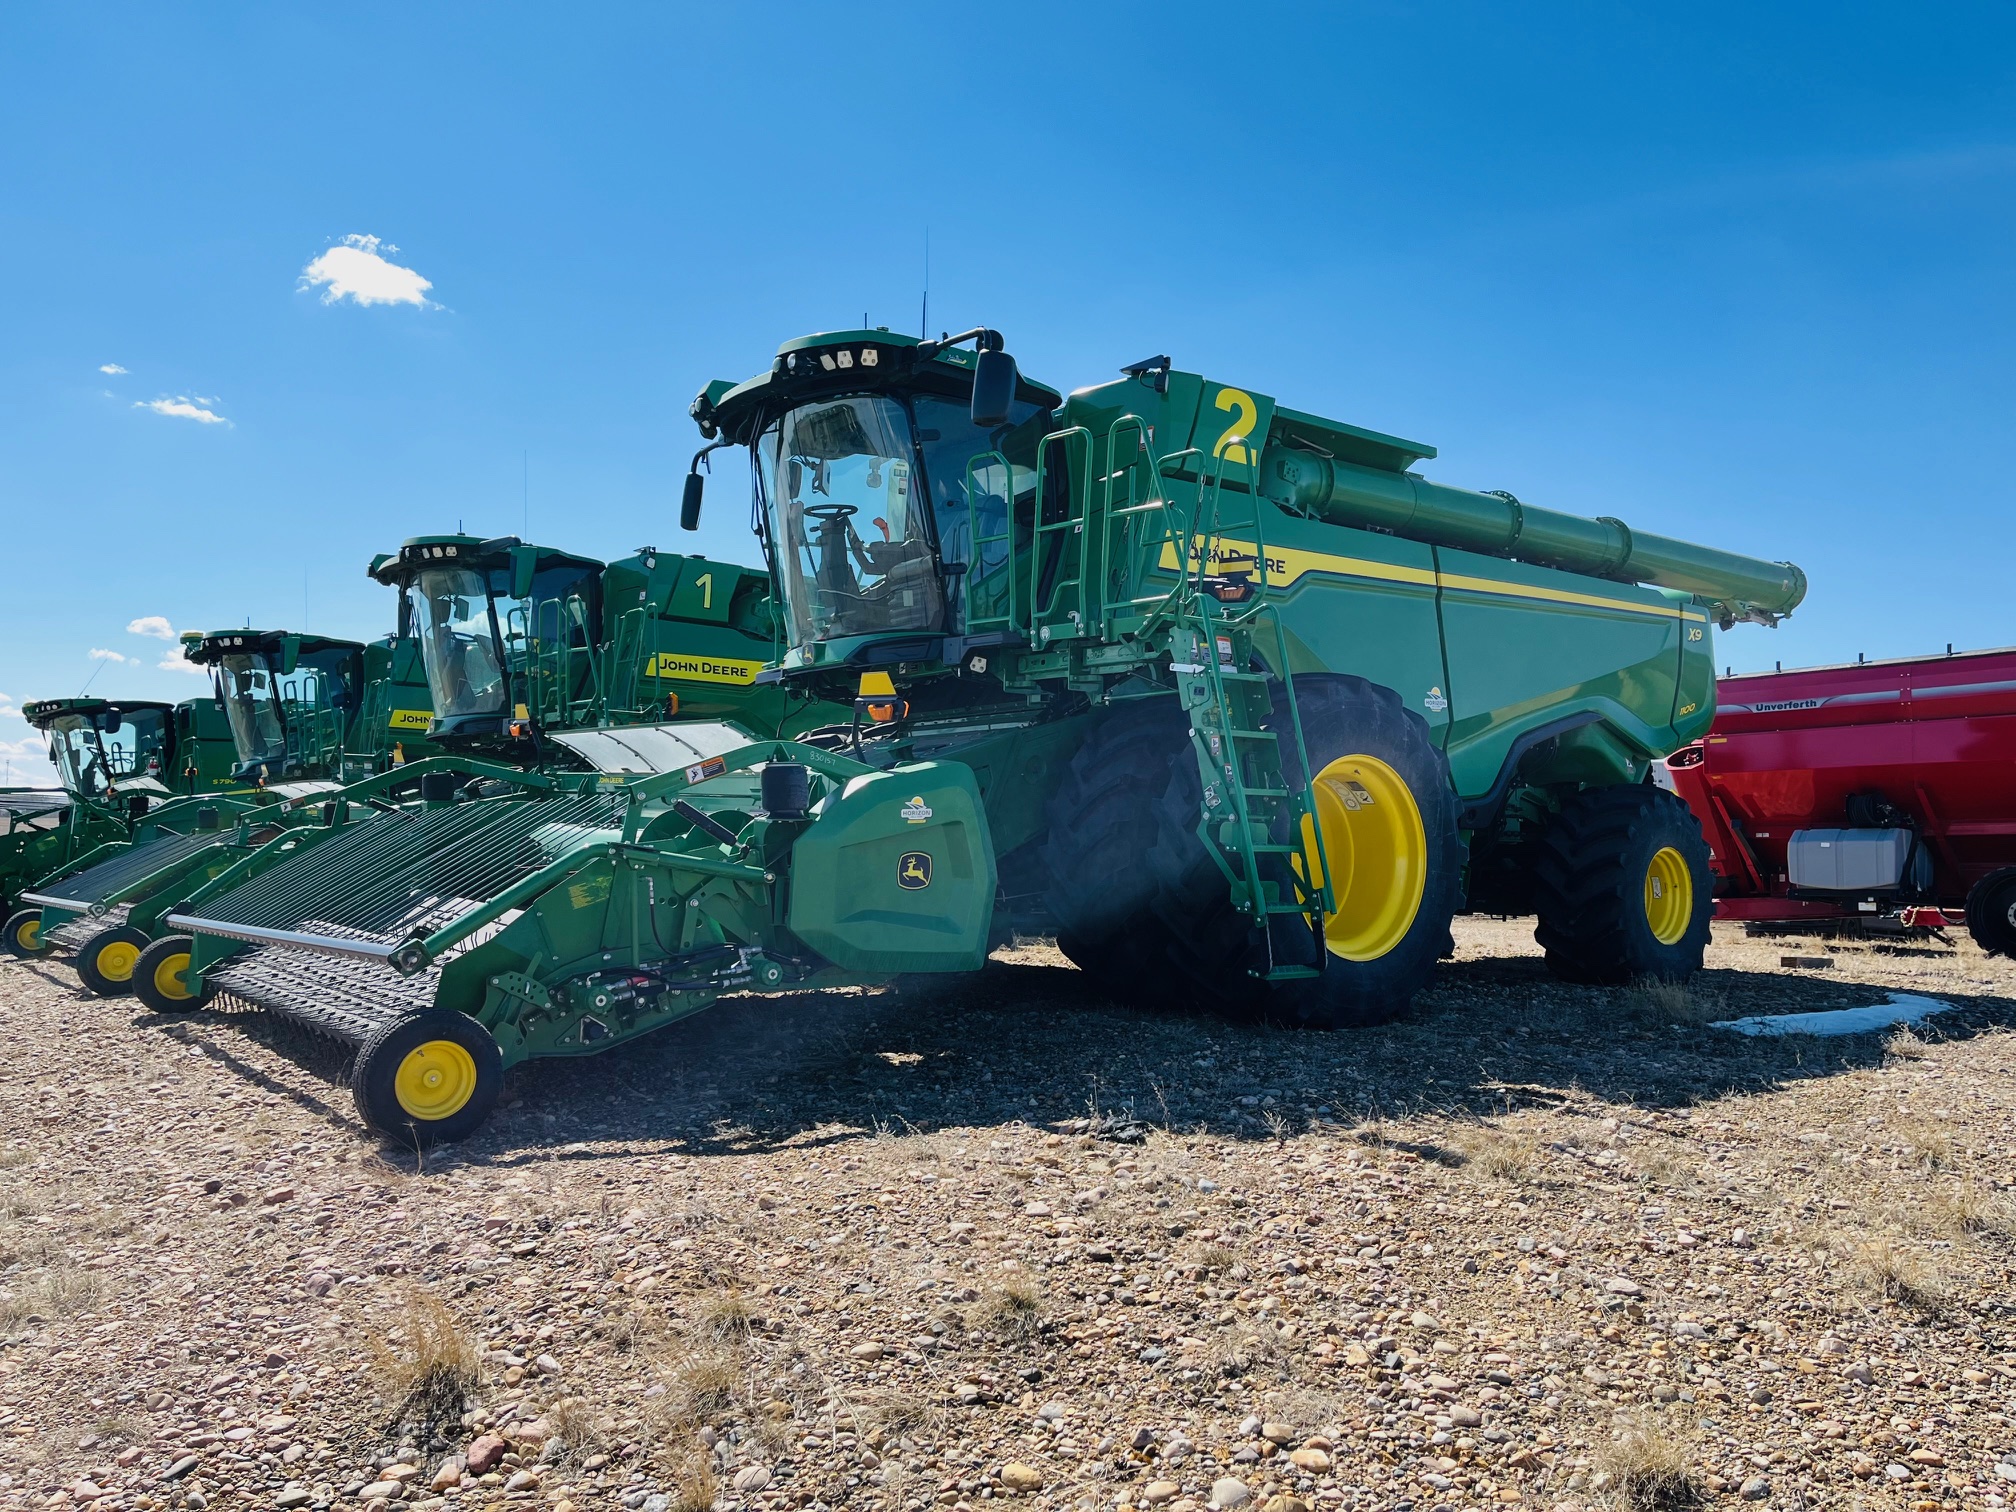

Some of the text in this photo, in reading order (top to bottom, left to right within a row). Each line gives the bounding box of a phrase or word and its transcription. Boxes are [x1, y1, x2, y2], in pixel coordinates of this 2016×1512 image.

[1213, 388, 1257, 467] 2
[695, 573, 711, 608] 1
[1688, 628, 1702, 641] X9
[660, 659, 748, 677] JOHN DEERE
[1756, 700, 1817, 711] Unverferth
[400, 714, 431, 723] JOHN
